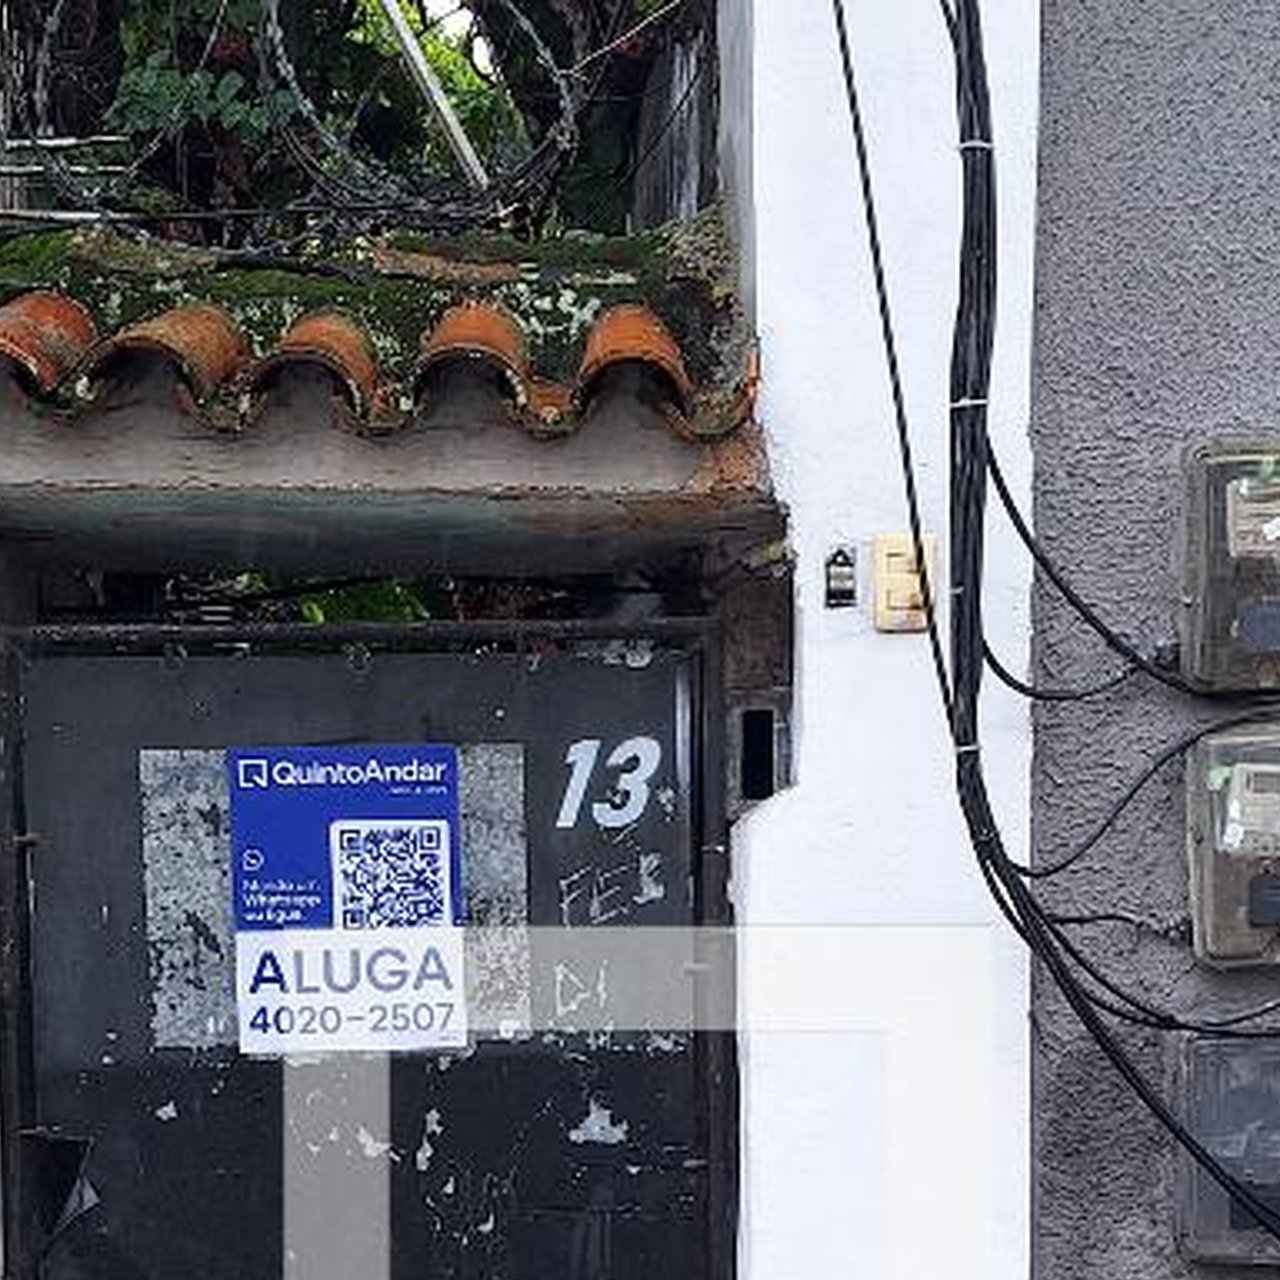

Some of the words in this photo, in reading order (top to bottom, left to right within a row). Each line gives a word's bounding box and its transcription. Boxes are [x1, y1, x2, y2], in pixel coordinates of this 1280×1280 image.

[272, 758, 448, 785] QuintoAndar
[556, 736, 662, 828] 13
[248, 948, 455, 995] ALUGA
[249, 1002, 456, 1035] 4020-2507
